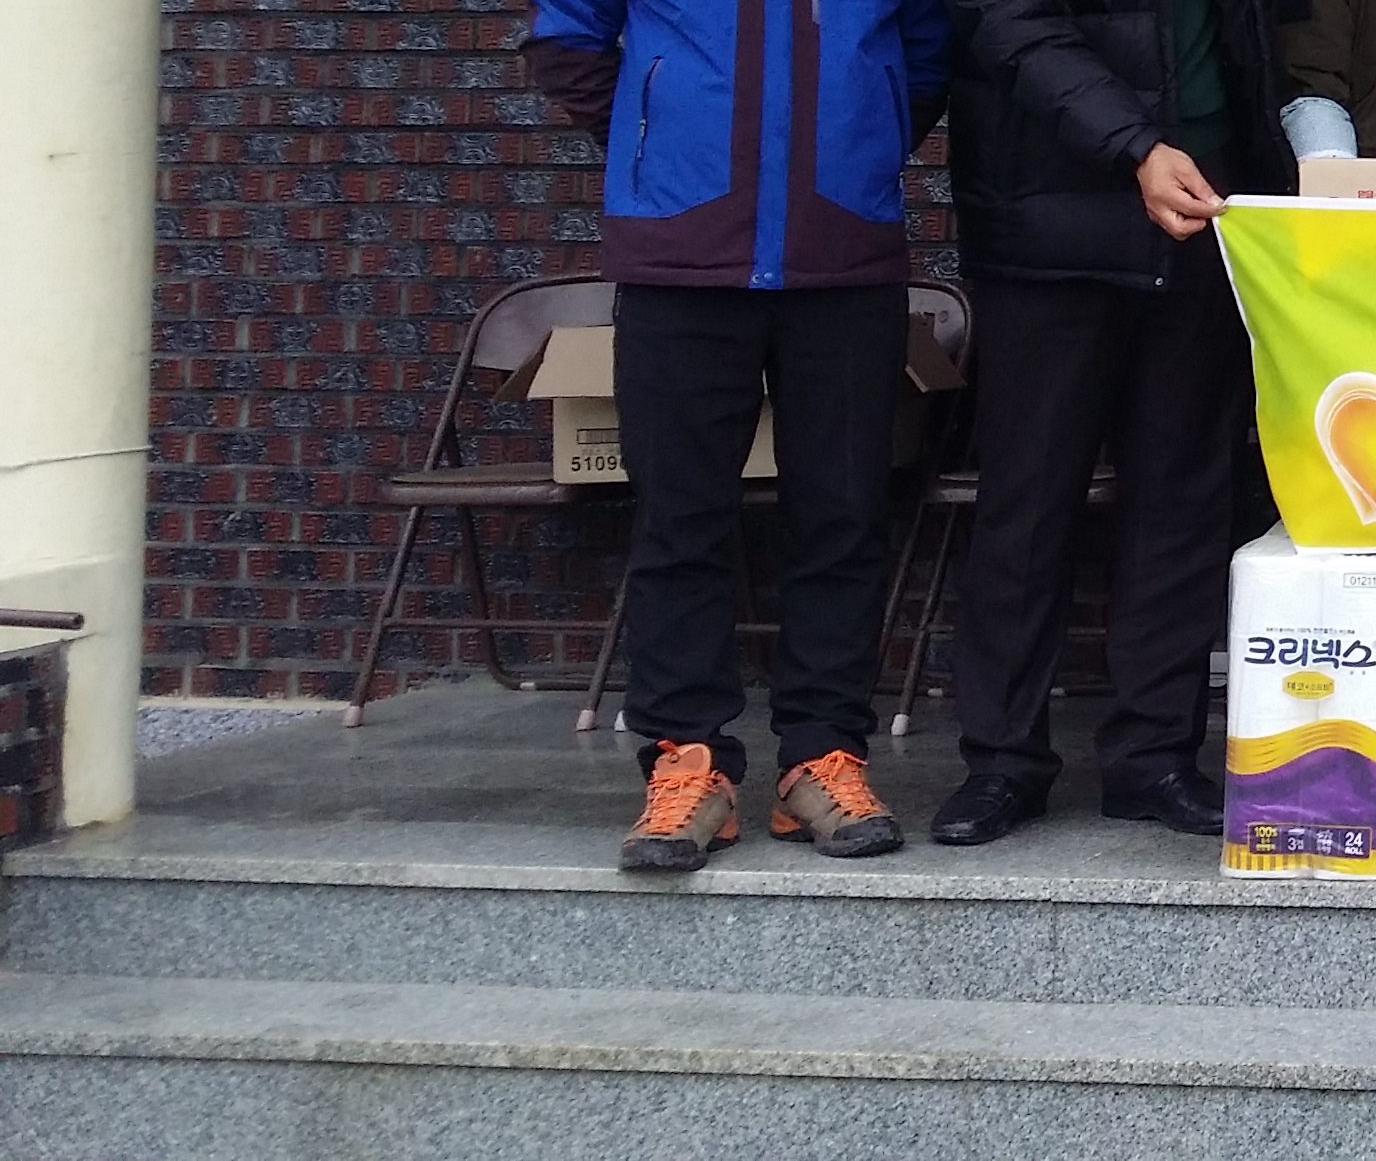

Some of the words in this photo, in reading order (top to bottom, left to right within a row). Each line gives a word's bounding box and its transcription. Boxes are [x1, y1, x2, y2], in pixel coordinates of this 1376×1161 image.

[1349, 576, 1376, 586] 01211
[1244, 636, 1376, 670] 크리넥스
[1344, 831, 1363, 847] 24
